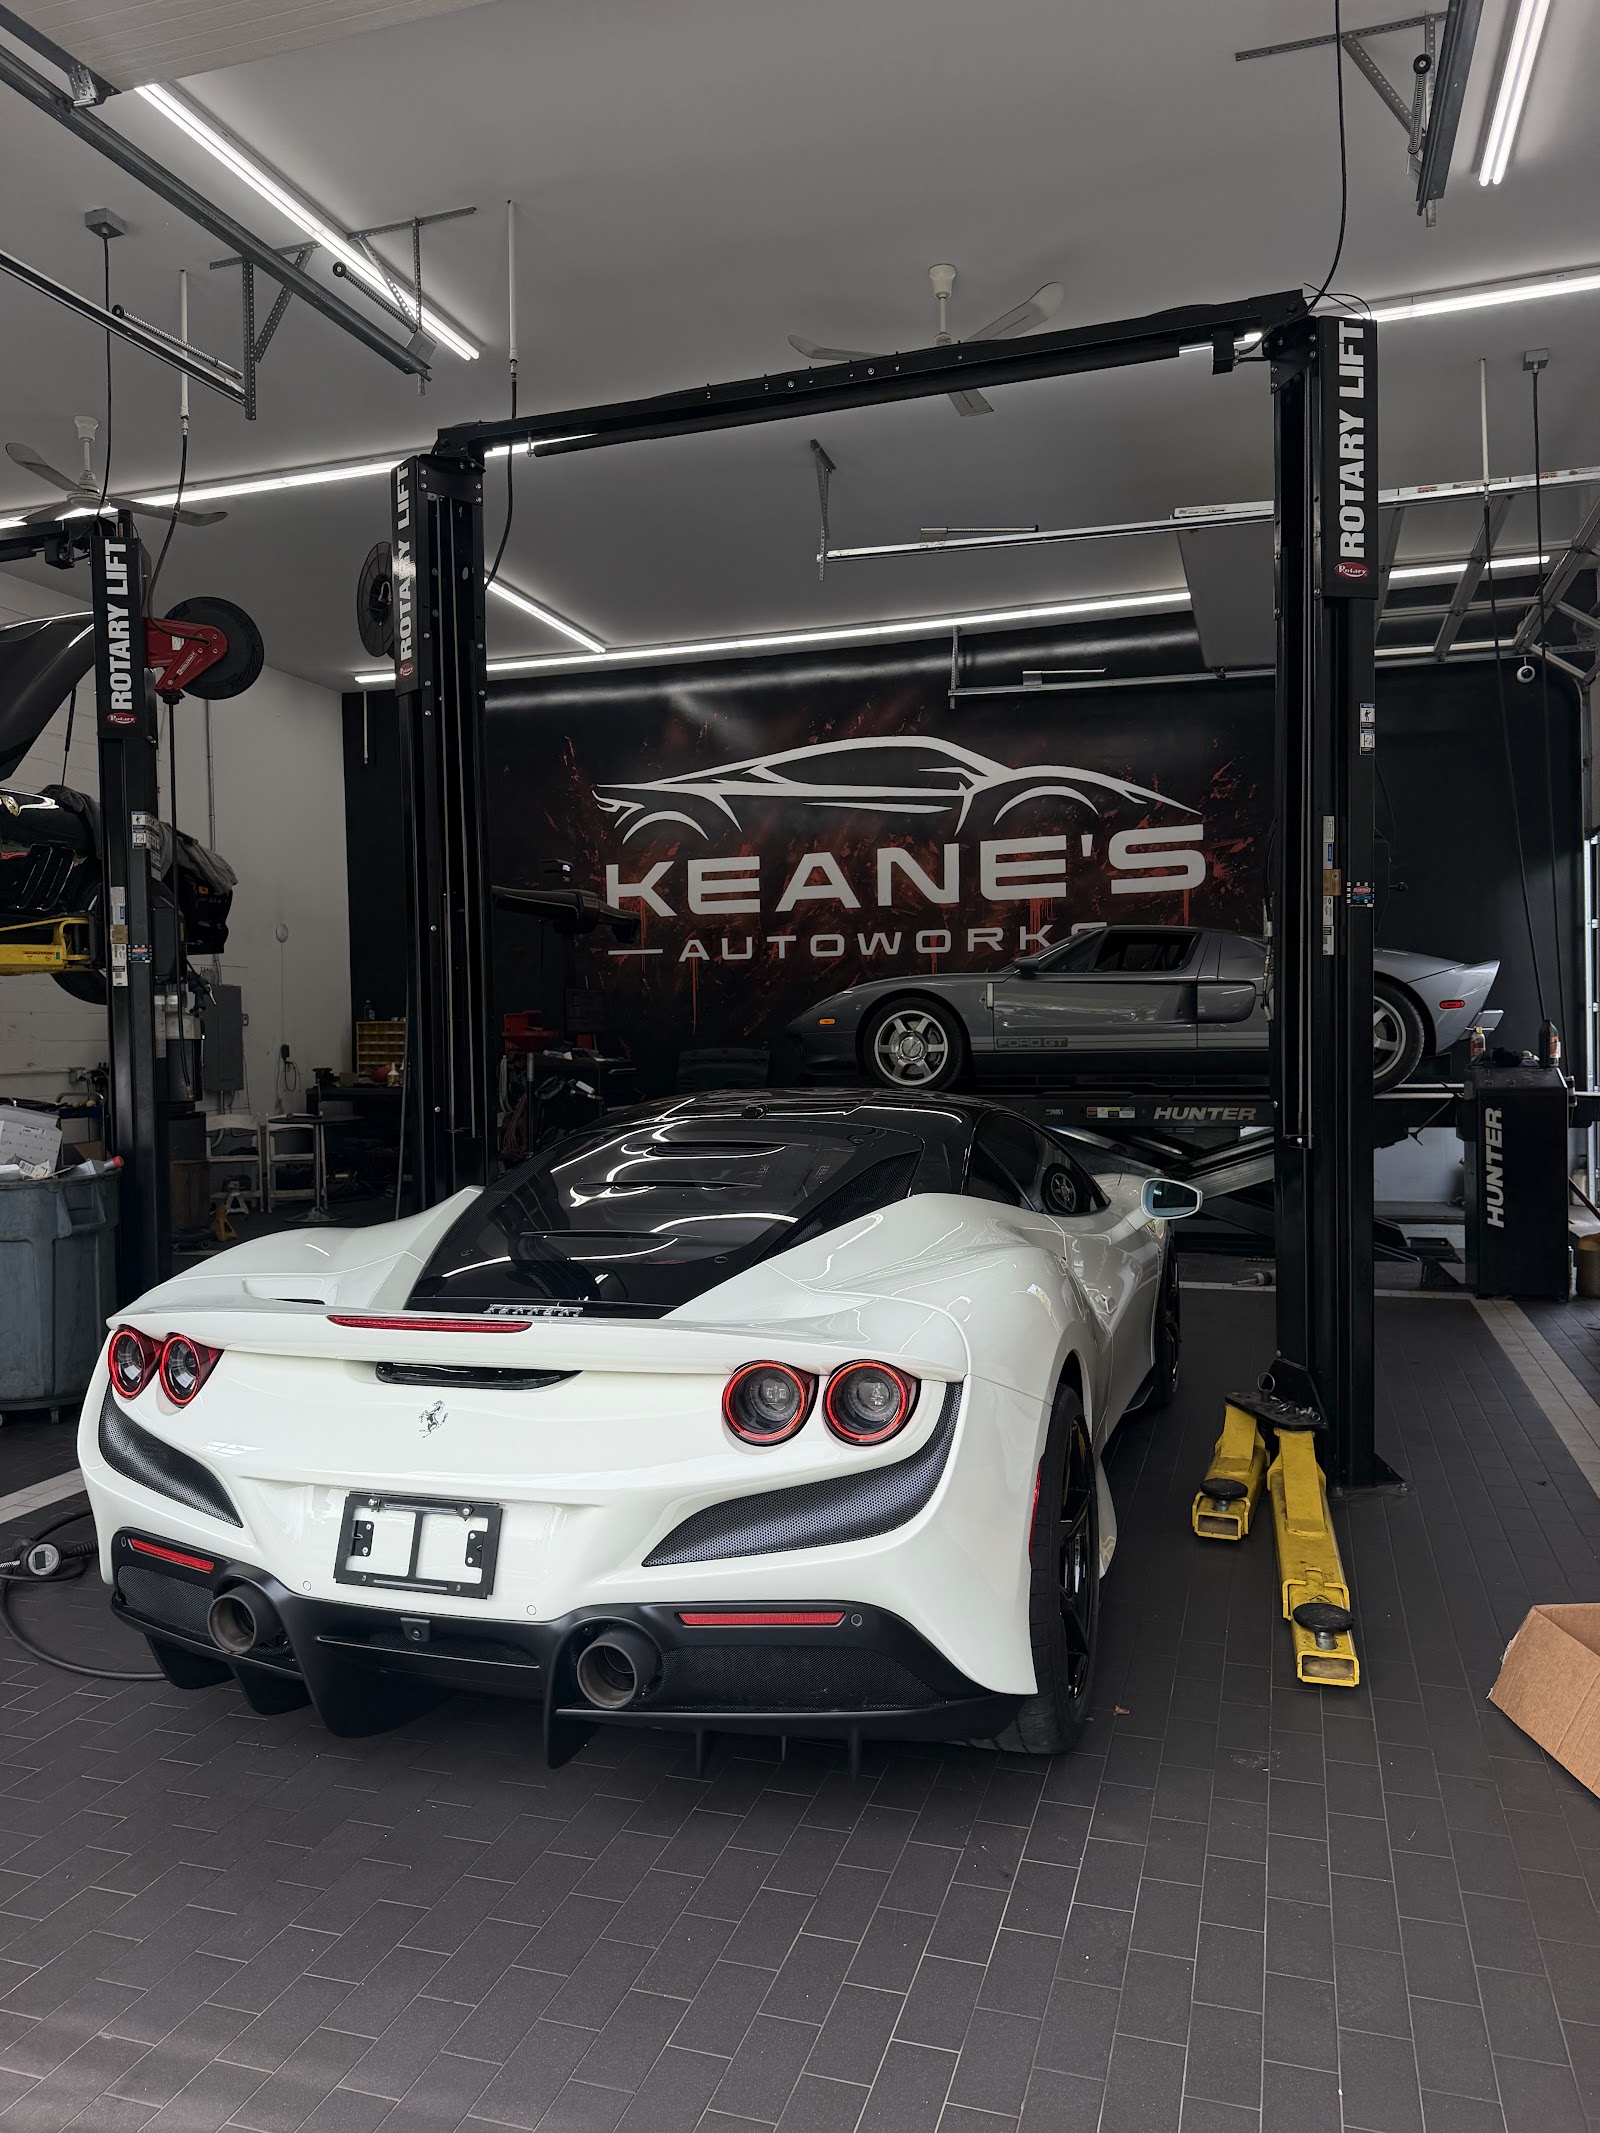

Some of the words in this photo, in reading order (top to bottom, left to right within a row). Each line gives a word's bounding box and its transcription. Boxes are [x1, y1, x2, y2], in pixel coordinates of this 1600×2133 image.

[1338, 321, 1364, 399] LIFT
[397, 467, 410, 530] LIFT
[1339, 409, 1365, 558] ROTARY
[105, 539, 129, 595] LIFT
[1338, 565, 1367, 577] Rotary
[107, 603, 133, 710] ROTARY
[606, 823, 1207, 918] KEANE'S
[998, 1038, 1041, 1047] FORD
[1044, 1038, 1067, 1047] GT
[1153, 1107, 1257, 1120] HUNTER
[1485, 1107, 1504, 1229] HUNTER
